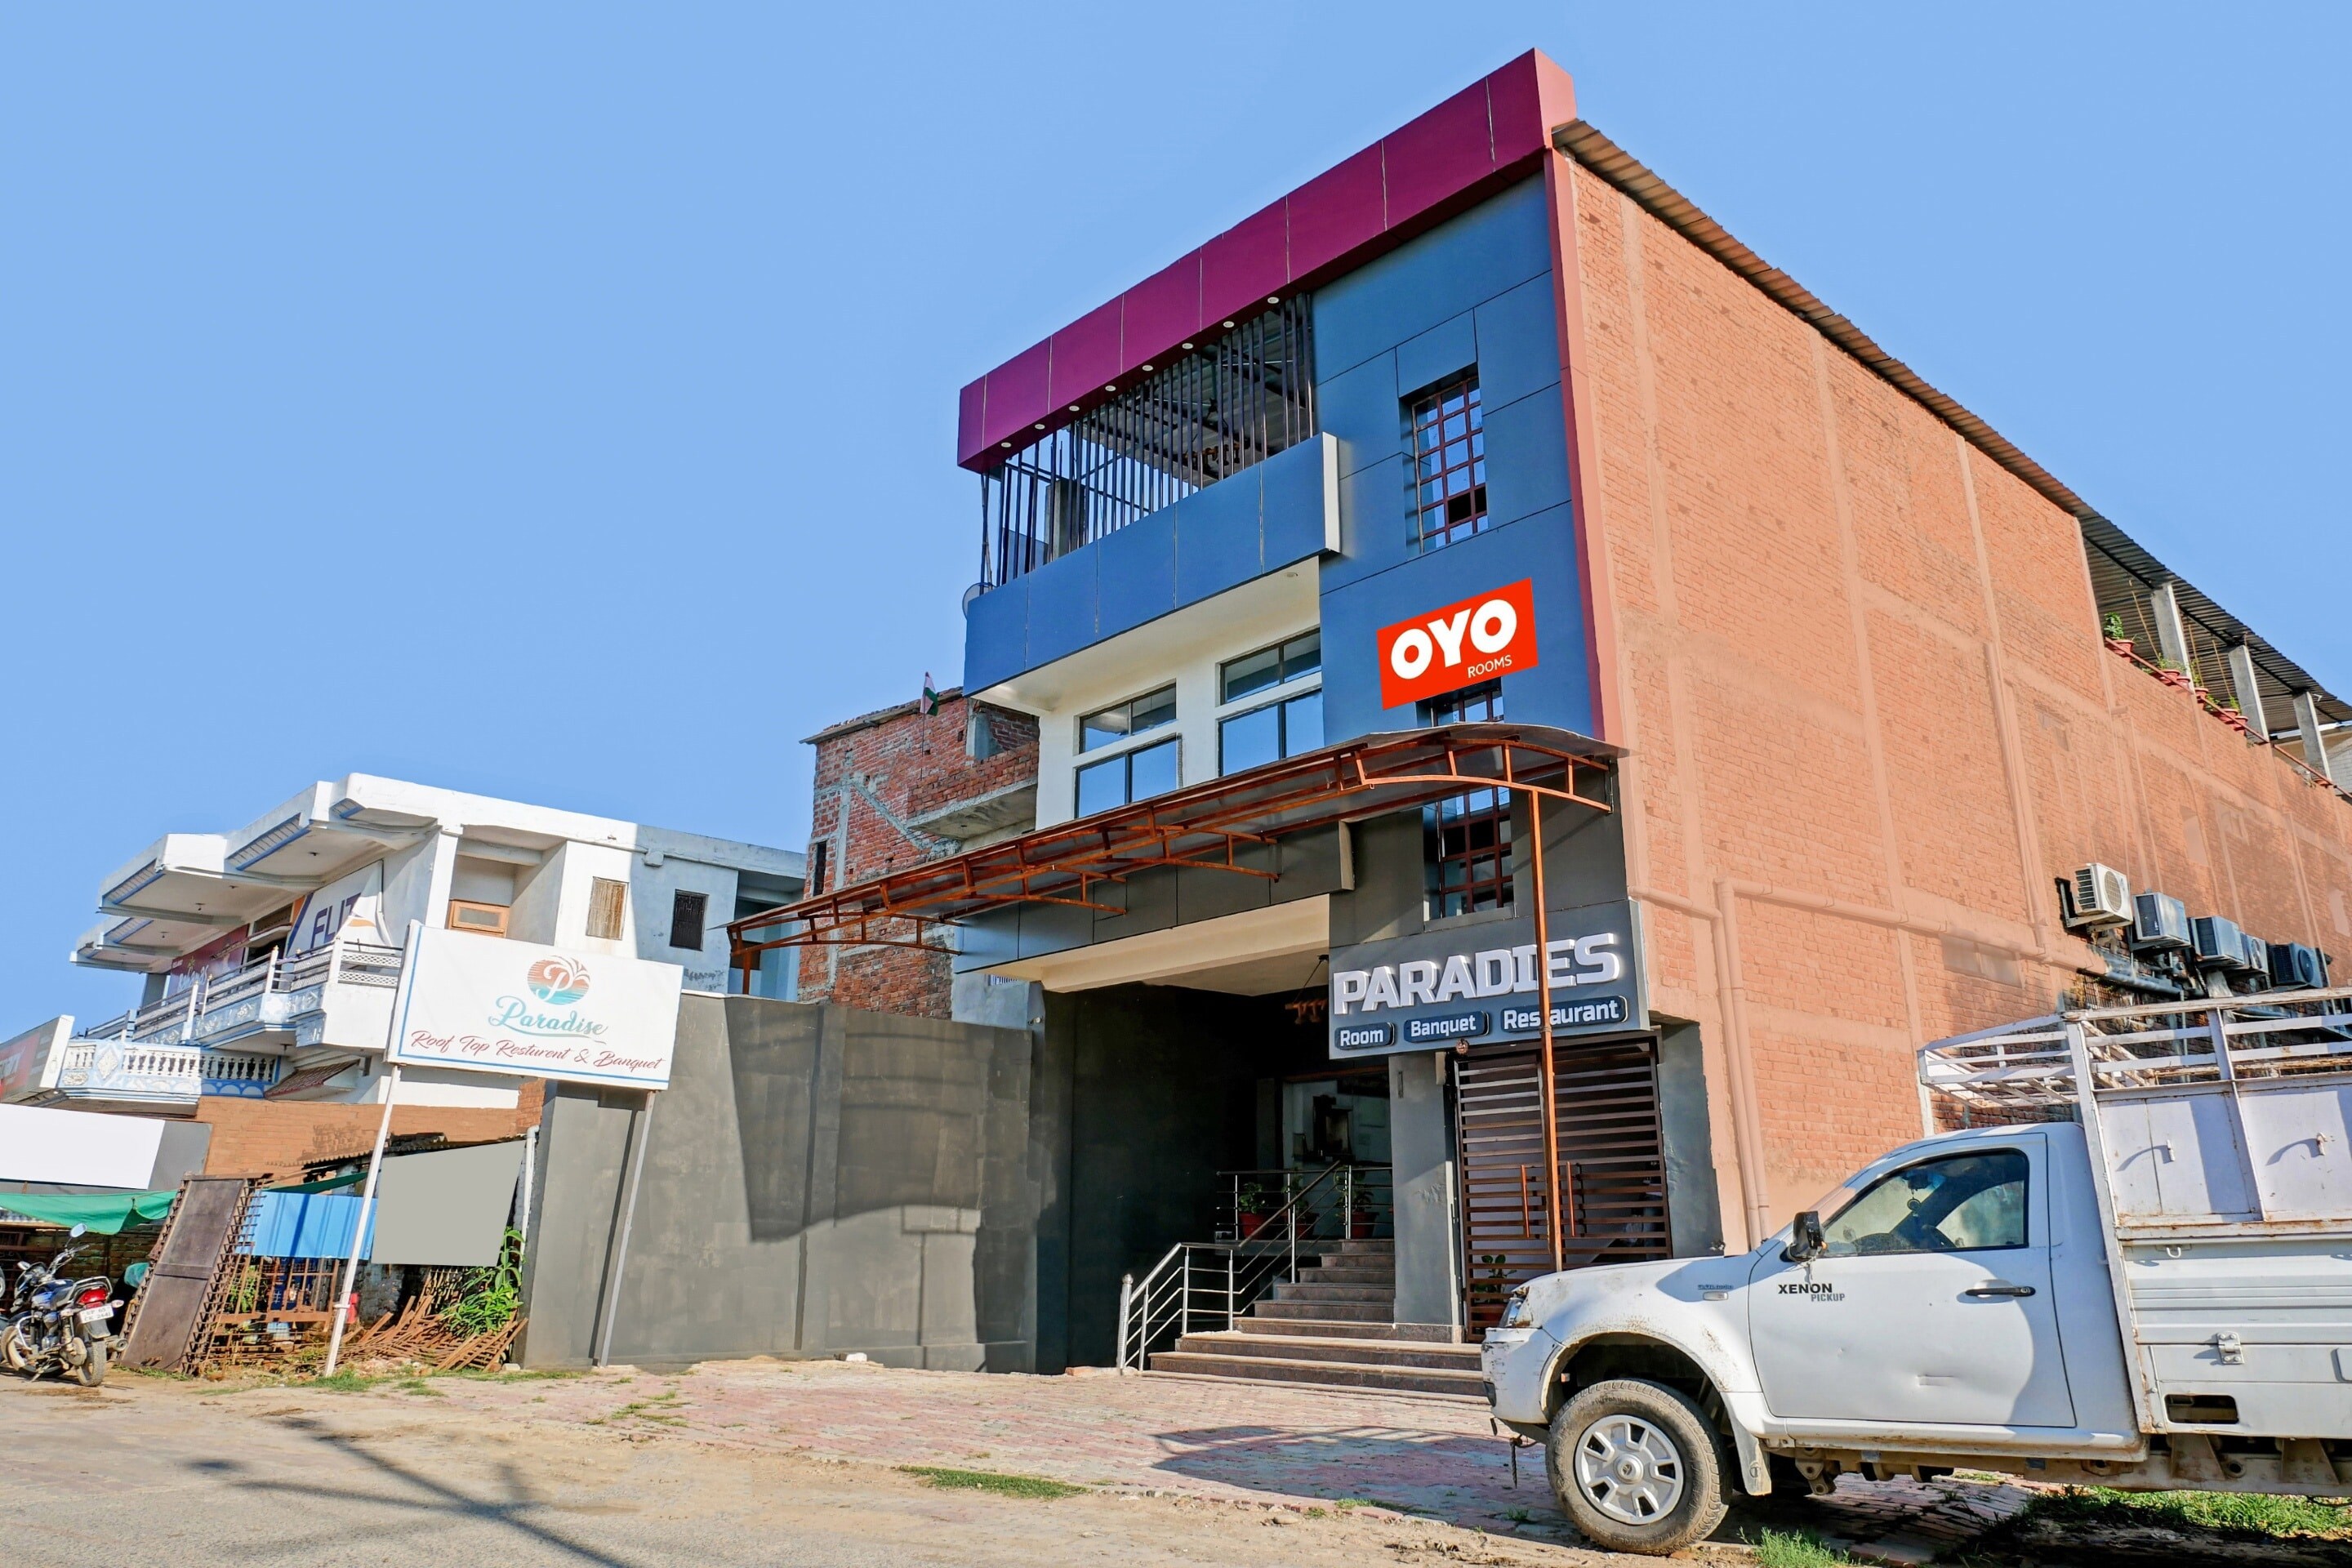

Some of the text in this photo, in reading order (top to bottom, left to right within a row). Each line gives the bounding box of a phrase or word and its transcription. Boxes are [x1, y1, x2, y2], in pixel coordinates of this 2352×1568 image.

[1390, 599, 1517, 679] OYO
[1467, 654, 1512, 679] ROOMS
[1333, 933, 1620, 1014] PARADIES
[488, 995, 608, 1036] Paradise
[1339, 999, 1619, 1047] Room Banquet Resaurant
[411, 1030, 455, 1054] Roof
[459, 1035, 490, 1057] Top
[573, 1049, 590, 1064] &
[593, 1049, 665, 1073] Banquet
[1778, 1283, 1833, 1294] XENON
[1811, 1293, 1846, 1303] PICKUP
